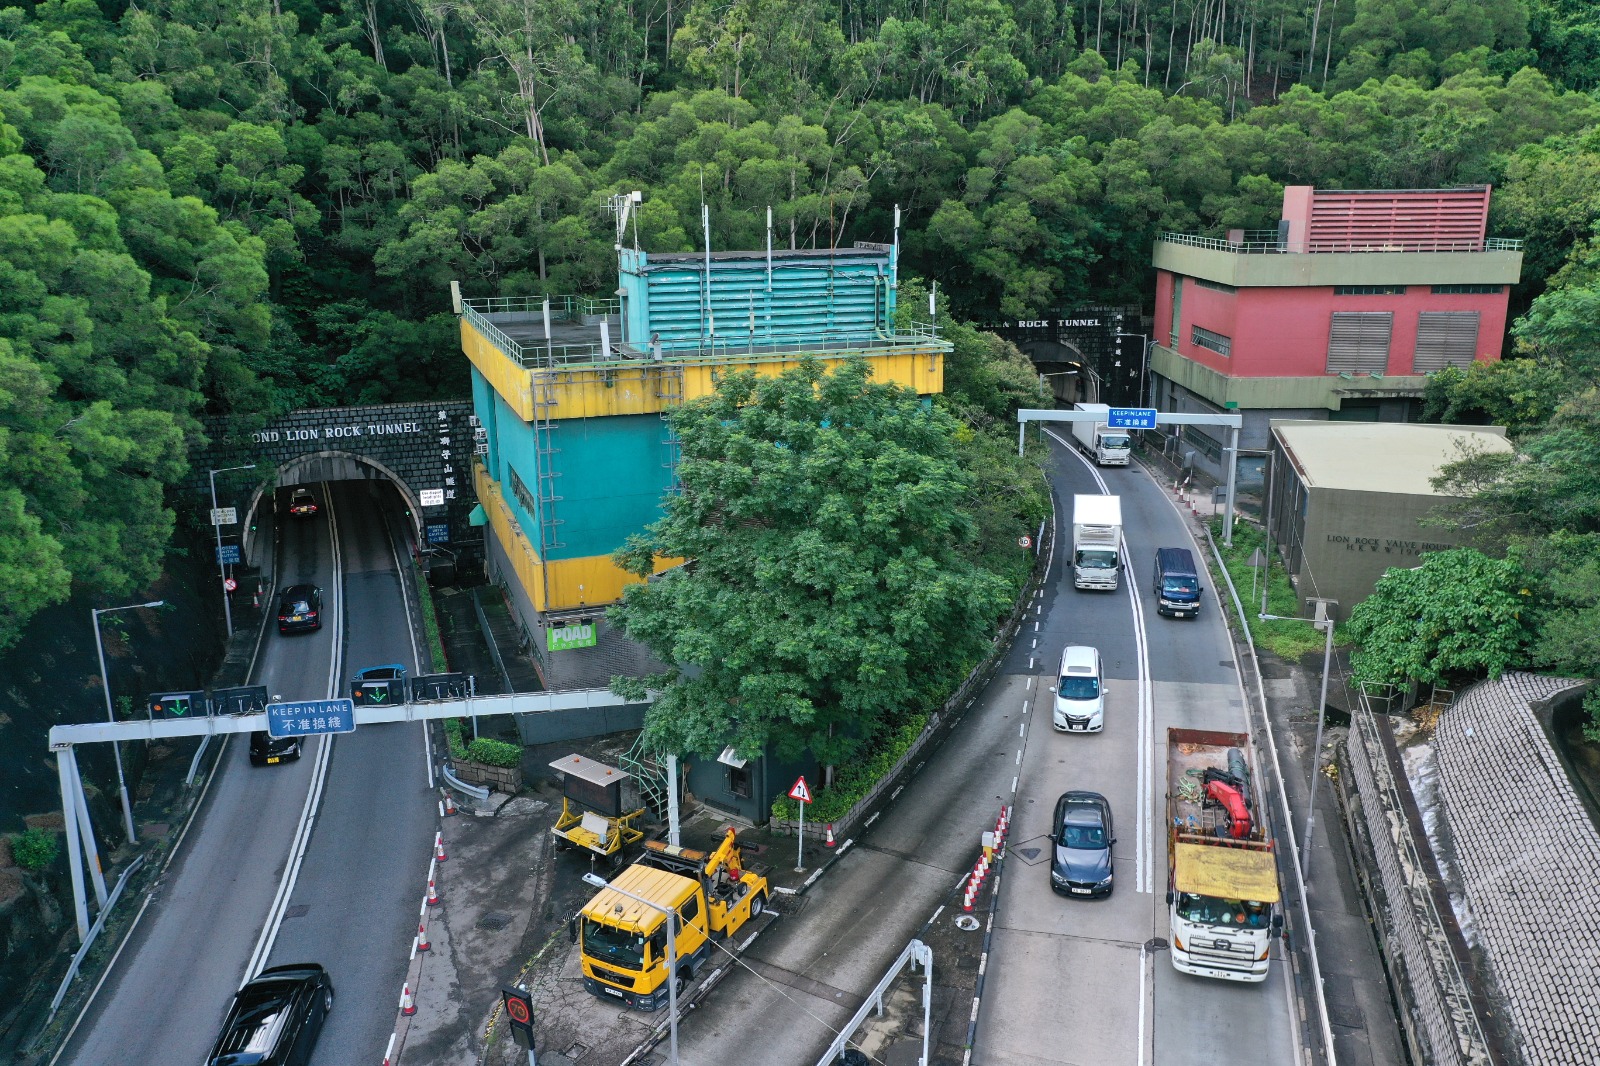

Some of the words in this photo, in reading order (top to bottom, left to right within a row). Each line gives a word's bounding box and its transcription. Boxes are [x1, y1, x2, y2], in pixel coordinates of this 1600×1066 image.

[1058, 319, 1101, 327] TUNNEL
[286, 429, 318, 441] LION
[325, 426, 361, 438] ROCK
[368, 422, 421, 435] TUNNEL
[1327, 535, 1349, 543] LION
[1355, 537, 1380, 546] ROCK
[1386, 539, 1416, 549] VALVE
[553, 625, 591, 643] POAD
[272, 707, 300, 716] KEEP
[303, 706, 316, 714] IN
[319, 704, 348, 713] LANE
[511, 1003, 525, 1016] 70
